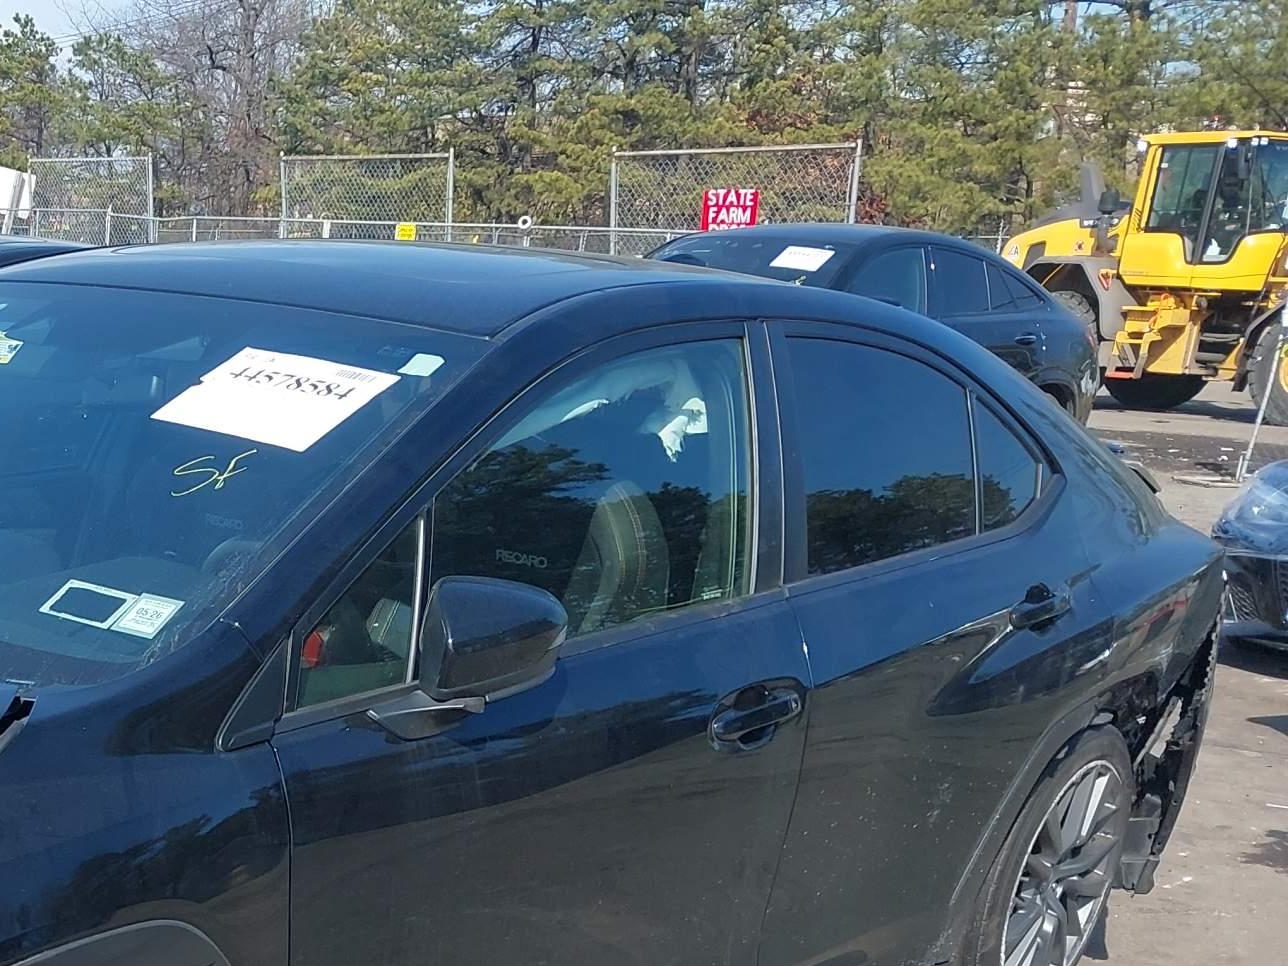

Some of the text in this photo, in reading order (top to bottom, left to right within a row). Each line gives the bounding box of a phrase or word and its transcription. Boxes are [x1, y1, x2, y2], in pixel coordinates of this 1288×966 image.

[707, 188, 755, 206] STATE
[708, 206, 752, 224] FARM
[229, 366, 356, 400] 44578584
[495, 549, 548, 569] RECARO
